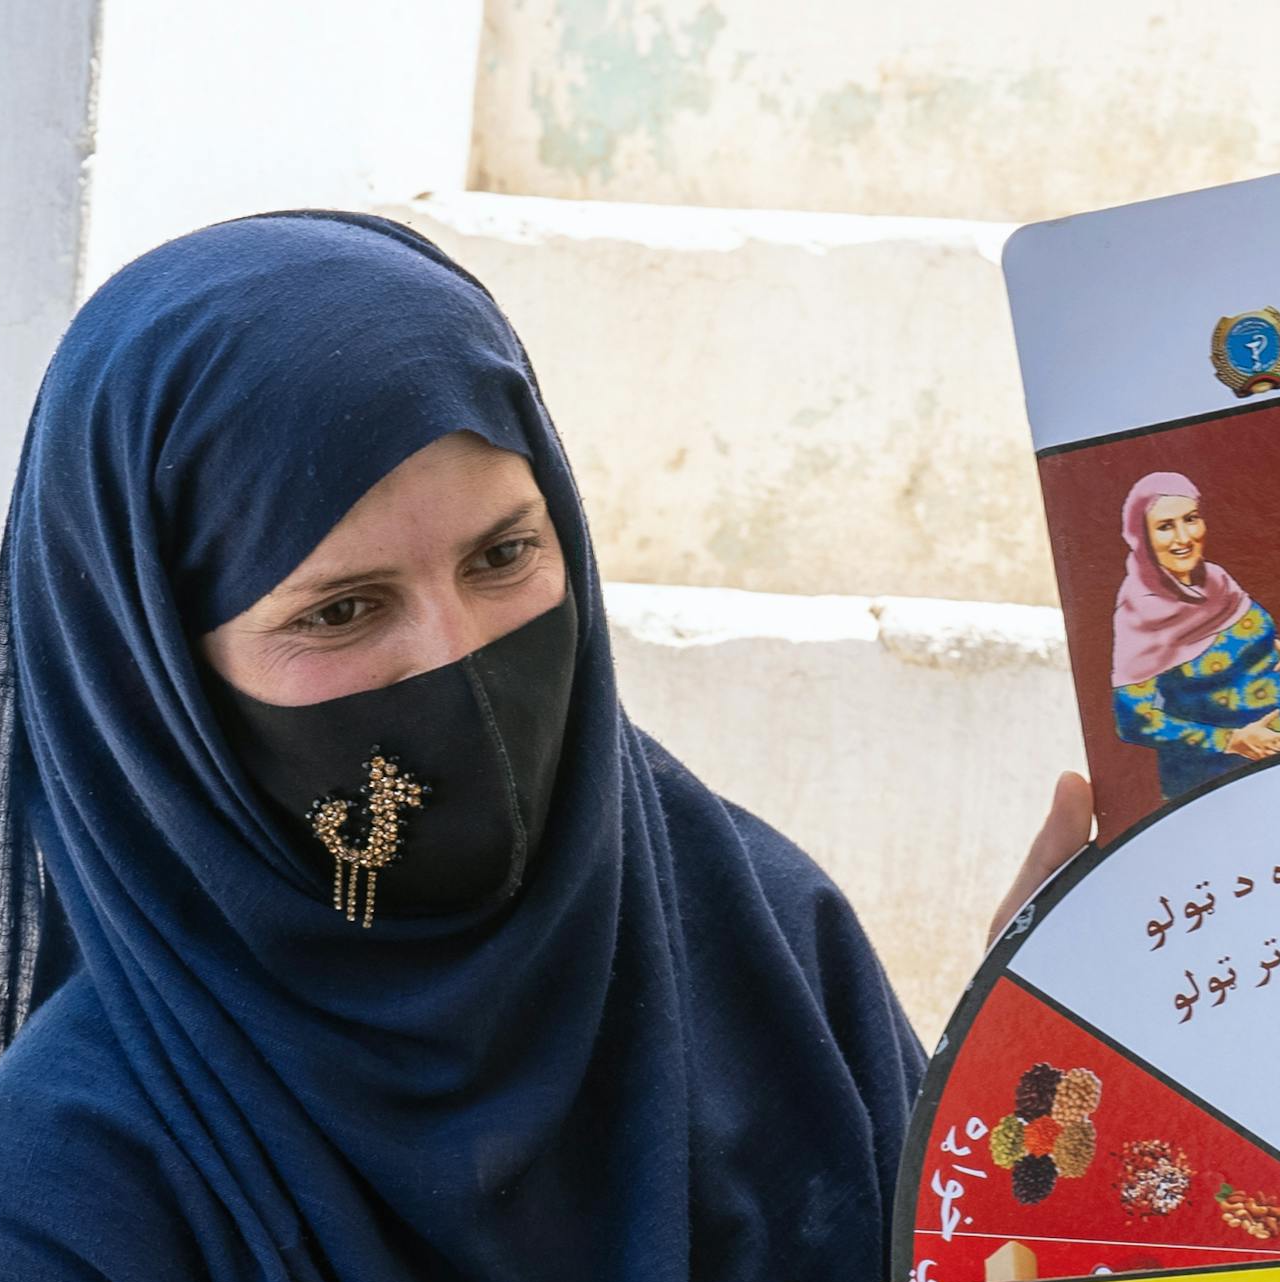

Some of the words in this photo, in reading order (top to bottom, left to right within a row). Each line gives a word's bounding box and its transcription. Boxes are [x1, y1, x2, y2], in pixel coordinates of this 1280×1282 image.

[1147, 881, 1216, 951] ټولو
[1233, 876, 1254, 898] د
[1174, 956, 1237, 1025] ټولو
[930, 1116, 989, 1243] خواړه
